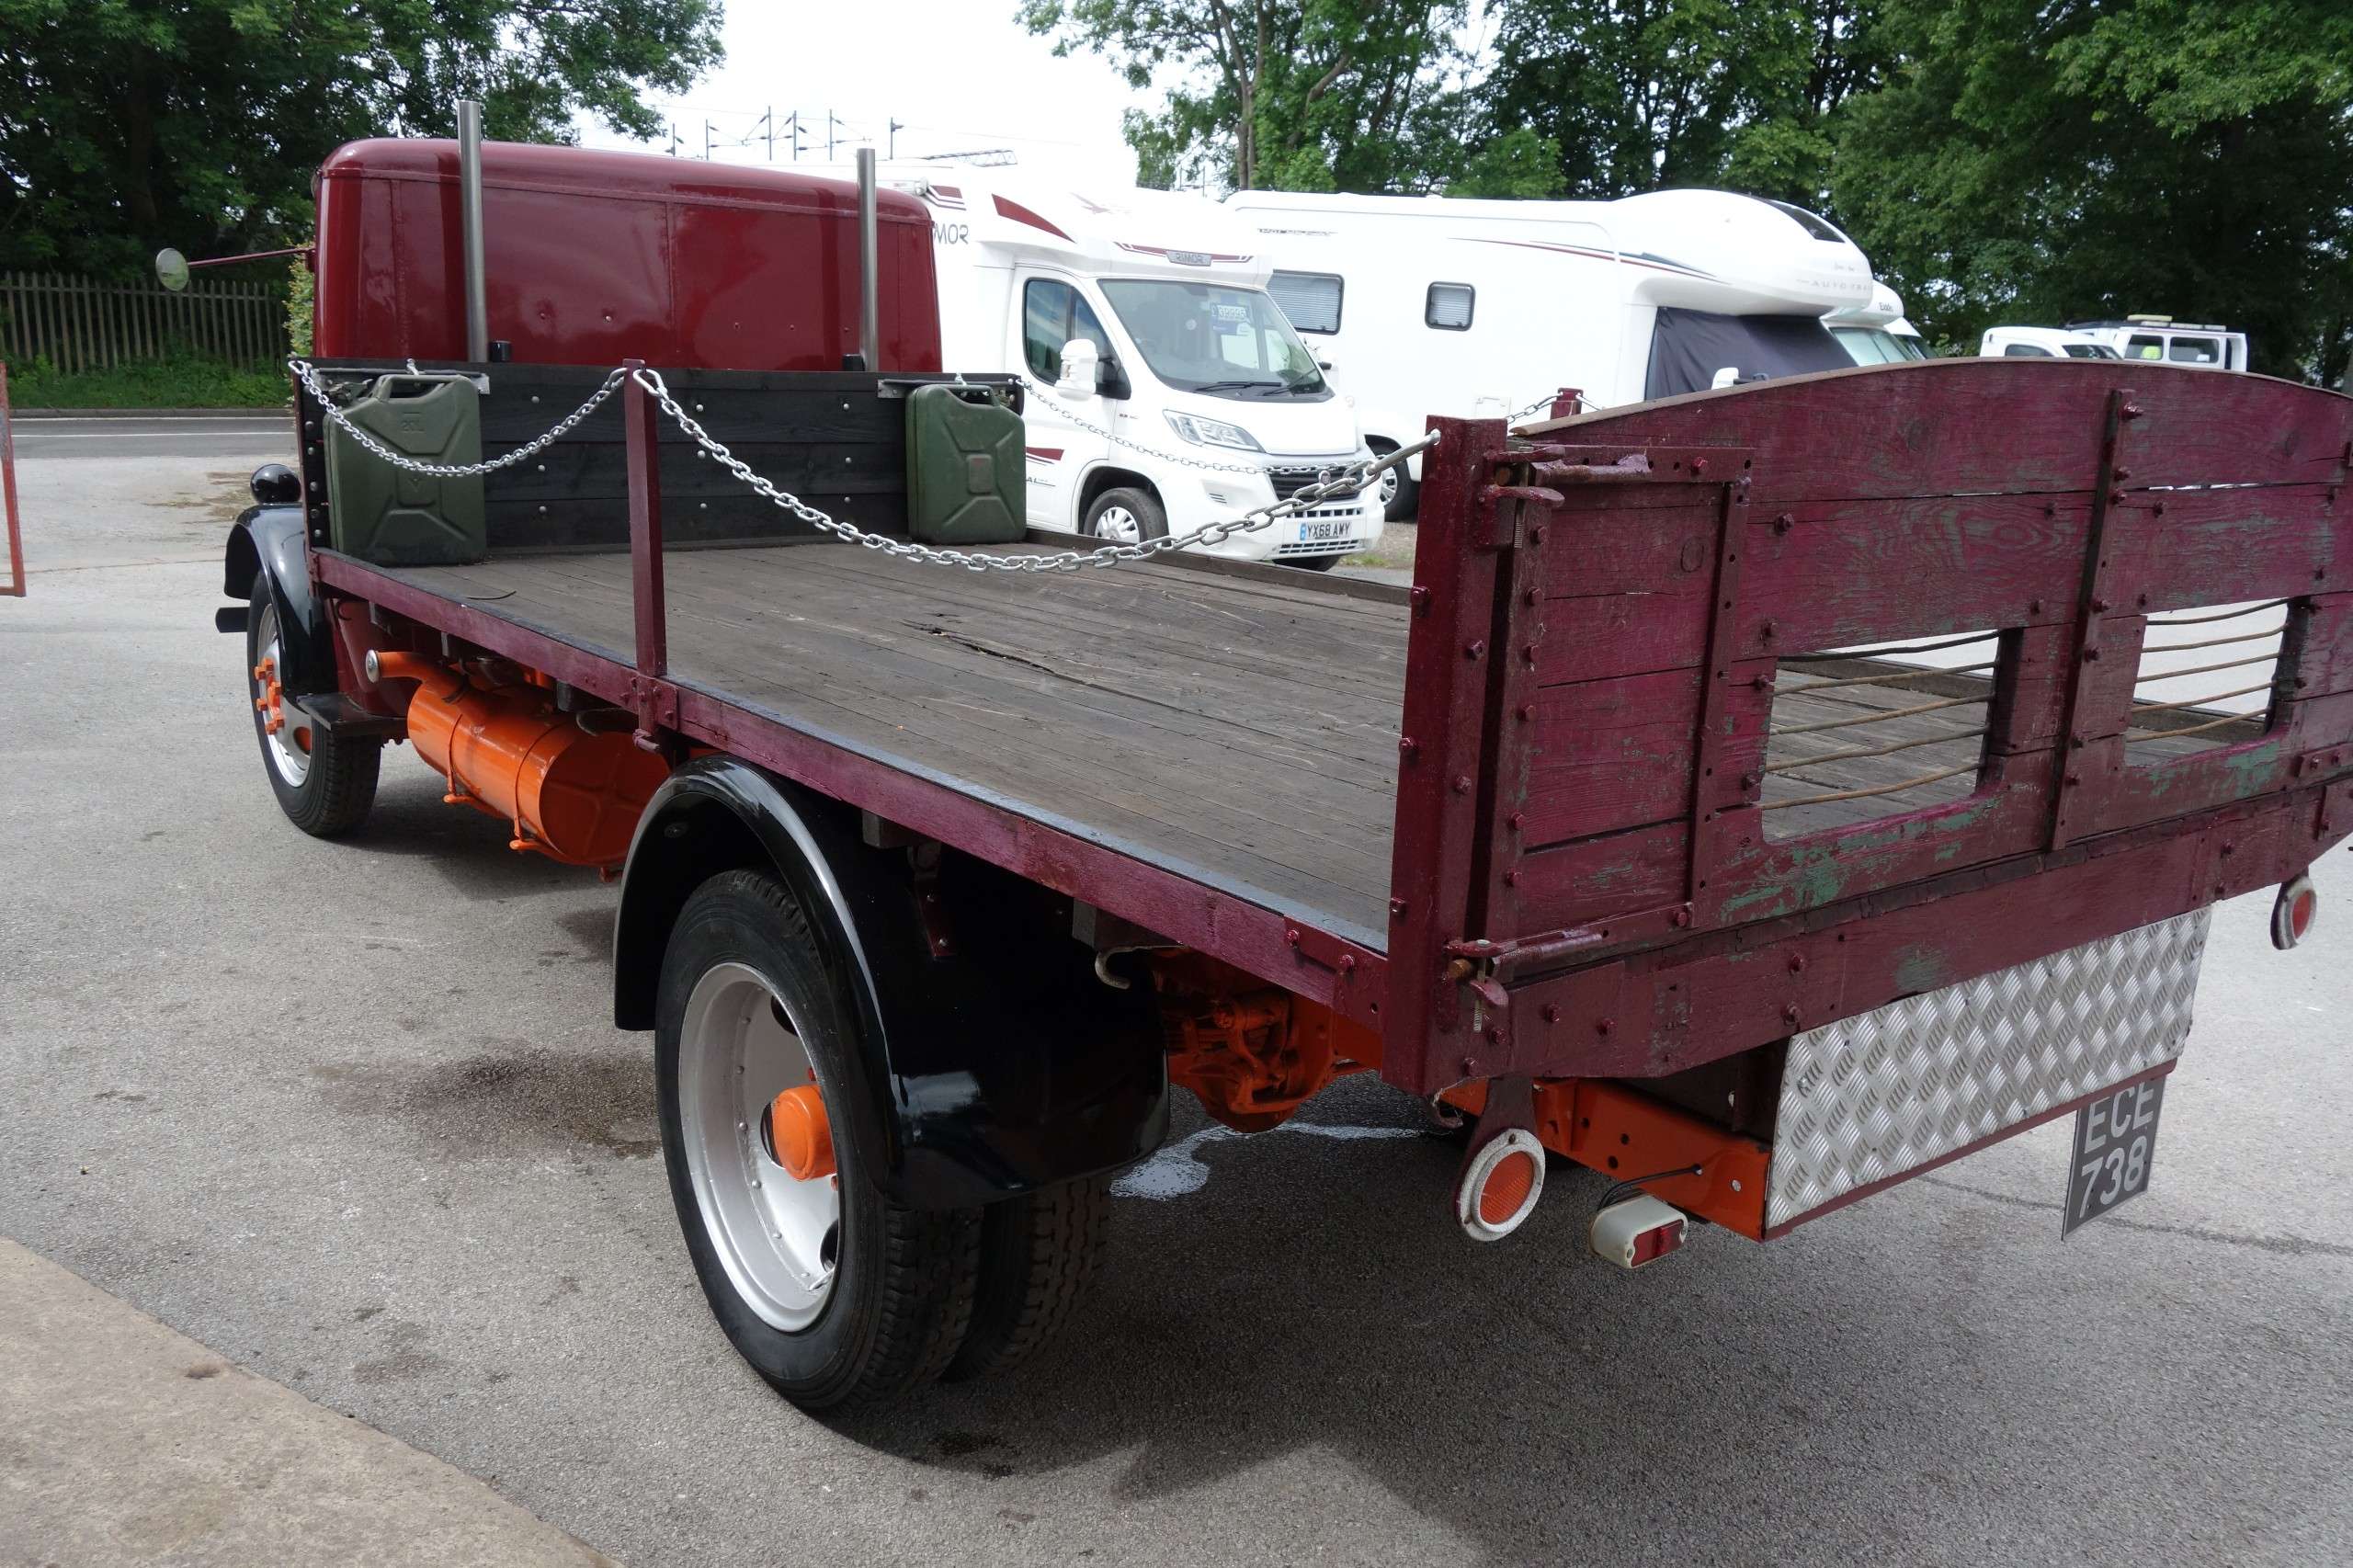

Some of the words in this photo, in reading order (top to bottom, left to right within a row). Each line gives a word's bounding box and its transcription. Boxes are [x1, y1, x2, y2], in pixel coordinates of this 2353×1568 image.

[934, 223, 969, 244] MOR
[1308, 523, 1331, 538] YX68
[1333, 521, 1350, 537] AWY
[2085, 1081, 2154, 1154] ECE
[2079, 1135, 2147, 1219] 738
